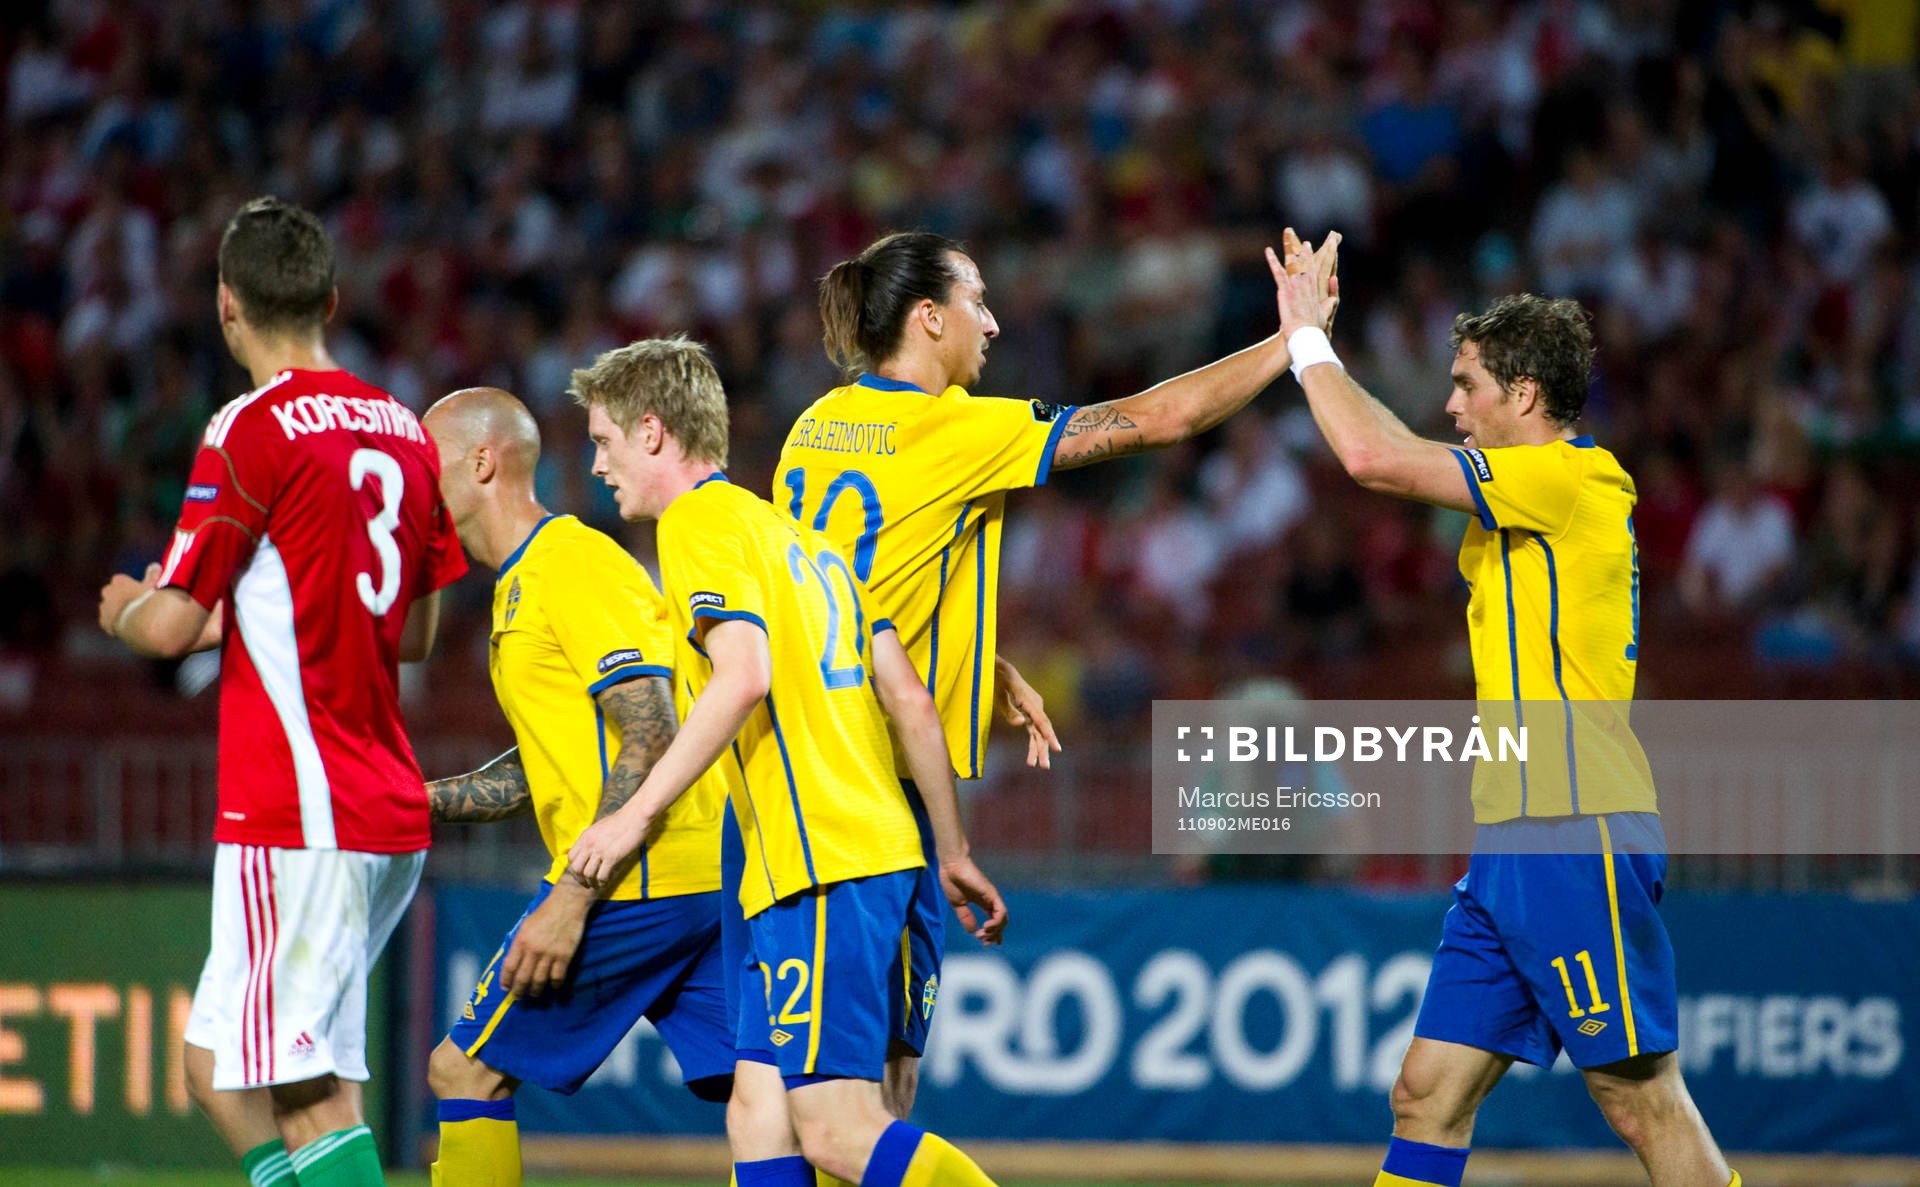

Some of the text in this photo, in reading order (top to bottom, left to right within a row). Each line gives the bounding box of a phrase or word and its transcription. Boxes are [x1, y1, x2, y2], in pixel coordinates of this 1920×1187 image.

[349, 448, 404, 616] 3
[785, 467, 884, 584] 10
[787, 543, 868, 690] 22
[921, 950, 1124, 1094] RO
[1130, 949, 1433, 1092] 2012
[1551, 950, 1610, 1018] 11
